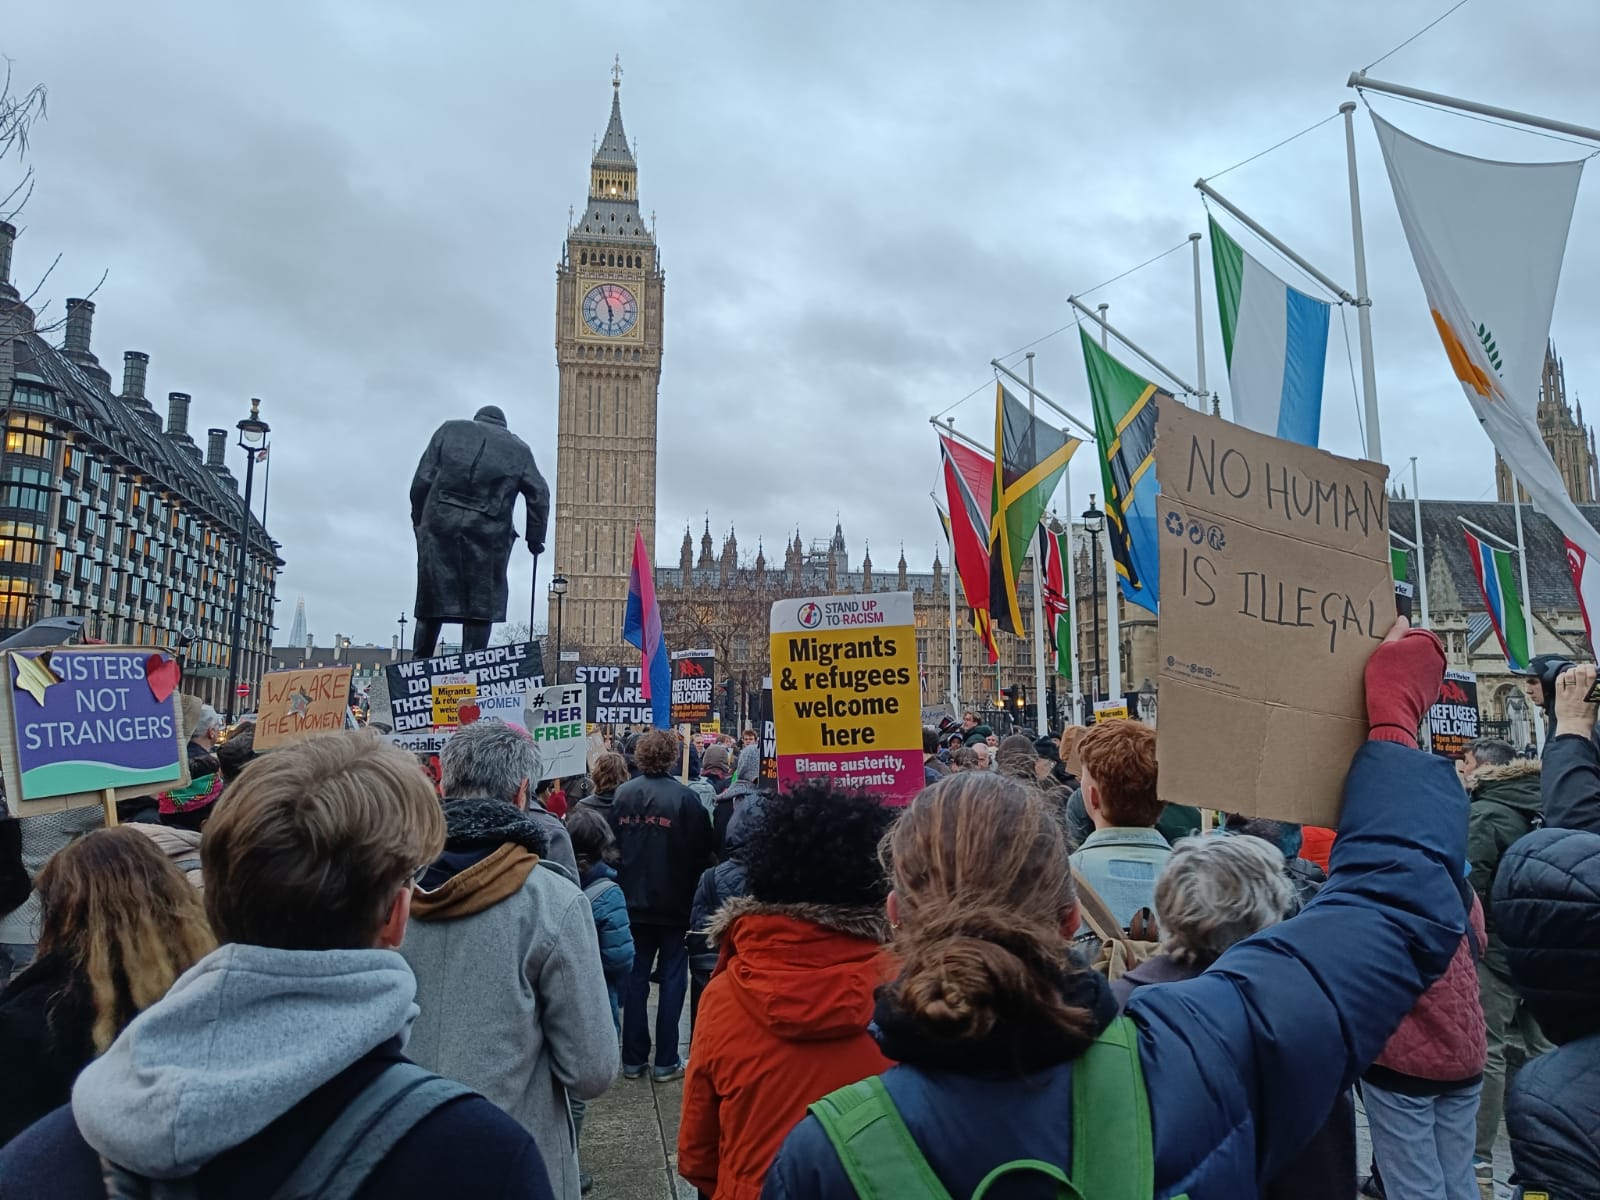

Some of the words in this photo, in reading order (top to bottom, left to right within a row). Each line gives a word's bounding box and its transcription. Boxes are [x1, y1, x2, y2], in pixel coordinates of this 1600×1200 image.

[1187, 435, 1250, 498] NO
[1266, 462, 1385, 537] HUMAN
[825, 601, 859, 614] STAND
[862, 600, 877, 612] UP
[1182, 548, 1216, 606] IS
[1237, 571, 1385, 653] ILLEGAL
[827, 614, 841, 626] TO
[843, 612, 884, 626] RACISM
[789, 635, 897, 666] Migrants
[50, 656, 145, 681] SISTERS
[398, 661, 425, 678] WE
[429, 655, 461, 673] THE
[465, 645, 527, 668] PEOPLE
[575, 666, 620, 683] STOP
[780, 667, 798, 691] &
[804, 665, 910, 692] refugees
[267, 675, 302, 704] WE
[309, 673, 349, 702] ARE
[408, 677, 429, 694] DO
[438, 687, 471, 697] Migrants
[672, 678, 712, 691] REFUGEES
[76, 687, 130, 713] NOT
[392, 694, 433, 714] THIS
[475, 675, 545, 698] ERNMENT
[443, 697, 459, 705] refu
[475, 696, 520, 709] WOMEN
[533, 690, 582, 708] #ET
[598, 687, 646, 703] CARE
[672, 691, 711, 704] WELCOME
[544, 707, 581, 724] HER
[596, 706, 653, 723] REFUG
[794, 694, 899, 719] welcome
[1431, 704, 1477, 722] REFUGEES
[24, 715, 173, 750] STRANGERS
[260, 711, 297, 737] THE
[293, 711, 343, 733] WOMEN
[533, 722, 582, 742] FREE
[1431, 719, 1478, 737] WELCOME
[821, 722, 875, 746] here
[795, 758, 837, 773] Blame
[840, 755, 905, 772] austerity,
